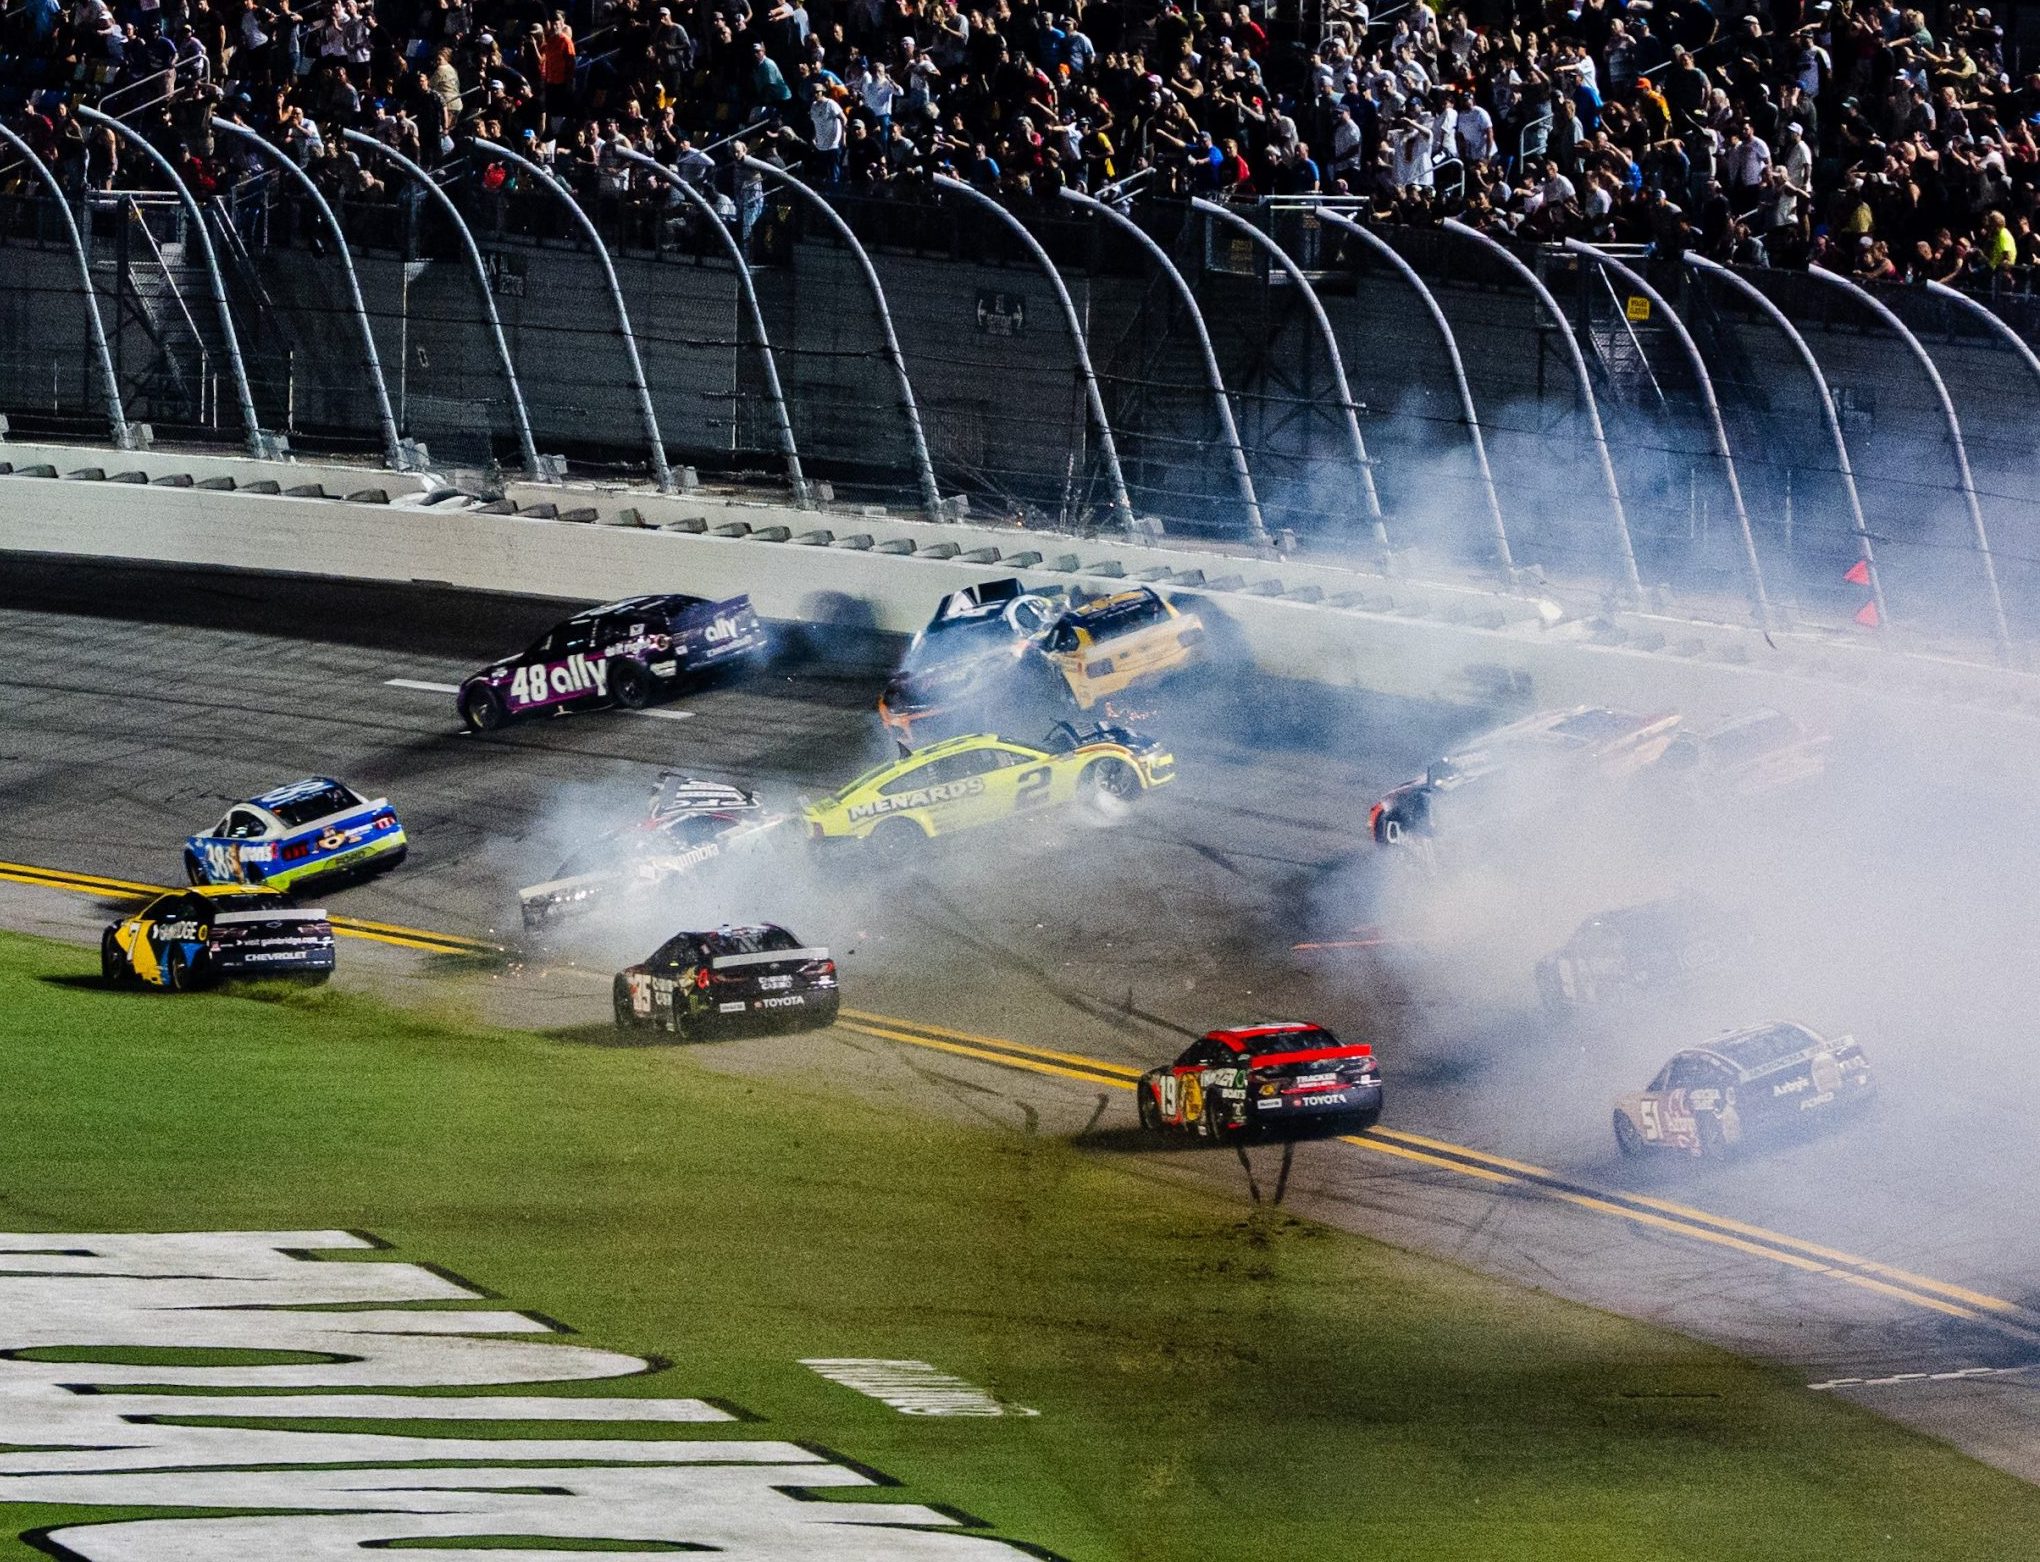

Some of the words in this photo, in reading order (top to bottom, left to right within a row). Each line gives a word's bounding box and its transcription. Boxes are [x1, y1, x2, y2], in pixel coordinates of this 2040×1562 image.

[705, 612, 739, 642] ally
[510, 663, 548, 704] 48
[550, 652, 607, 697] ally
[849, 778, 985, 822] MENARDS
[1015, 766, 1050, 812] 2
[127, 922, 142, 961] 7
[245, 951, 307, 962] CHEVROLET
[763, 996, 805, 1009] TOYOTA
[1160, 1075, 1177, 1116] 19
[1303, 1094, 1347, 1107] TOYOTA
[1641, 1101, 1663, 1140] 51
